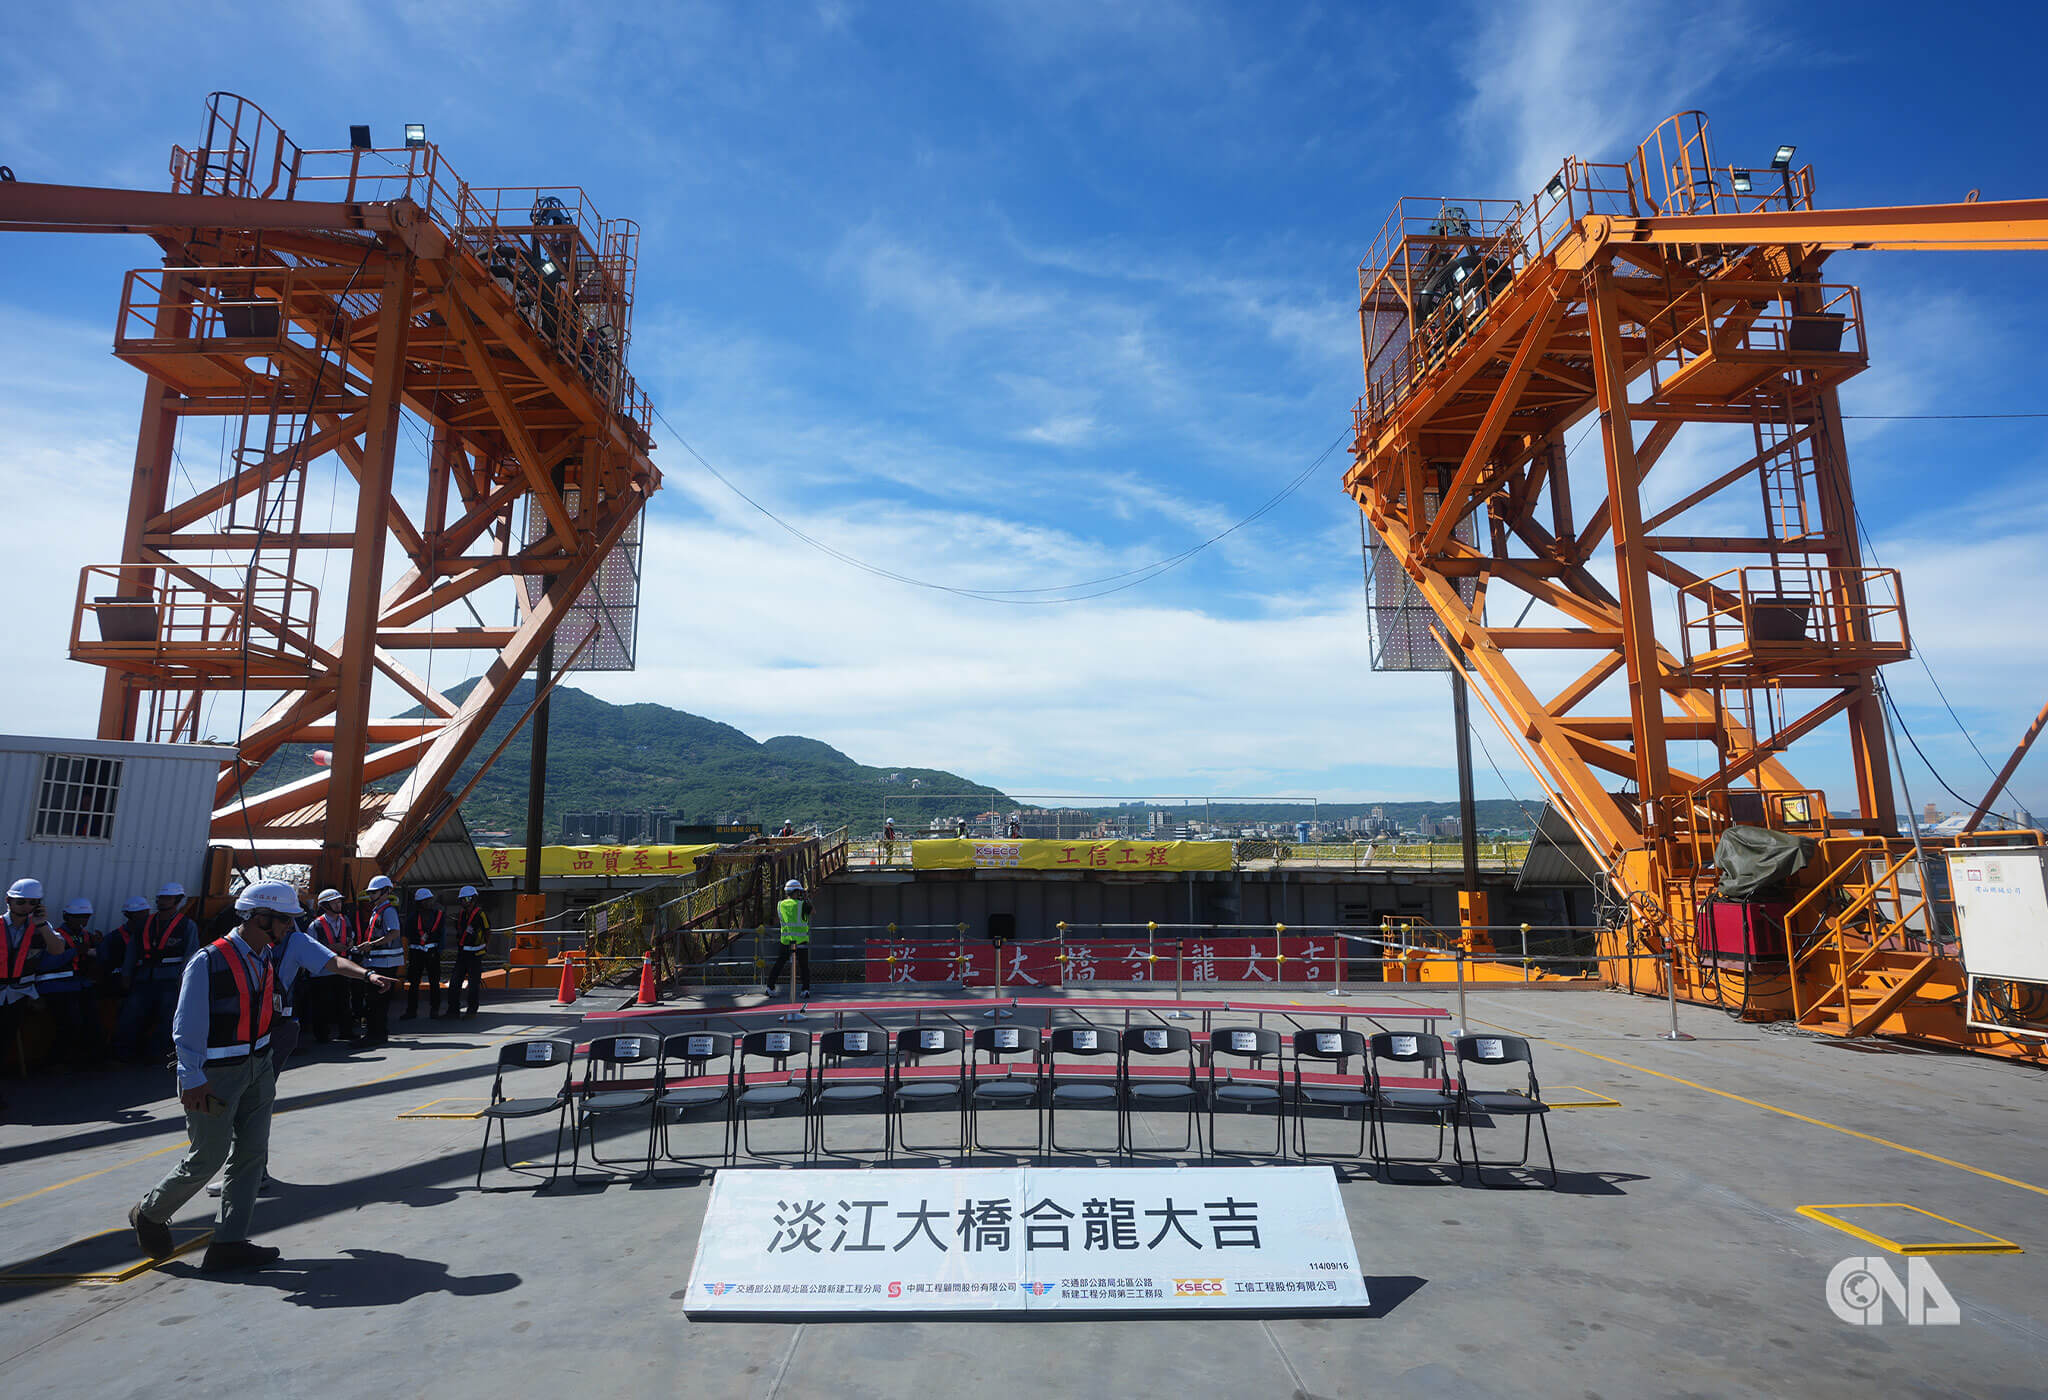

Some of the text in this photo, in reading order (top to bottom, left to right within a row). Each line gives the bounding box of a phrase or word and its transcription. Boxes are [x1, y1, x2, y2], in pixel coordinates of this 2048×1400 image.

[976, 847, 1019, 856] KSECO
[1057, 845, 1169, 867] 工信工程
[572, 848, 684, 872] 品質至上
[767, 1197, 1261, 1253] 淡江大橋合龍大吉
[1309, 1262, 1349, 1271] 114/09/16
[906, 1282, 1017, 1293] 中興工程顧問股份有限公司
[1061, 1278, 1153, 1288] 交通部公路局北區公路
[1176, 1283, 1222, 1292] KSECO
[1234, 1281, 1337, 1292] 工信工程股份有限公司
[736, 1283, 882, 1295] 交通部公路局北區公路新建工程分局
[1061, 1289, 1164, 1299] 新建工程分局第三工務段
